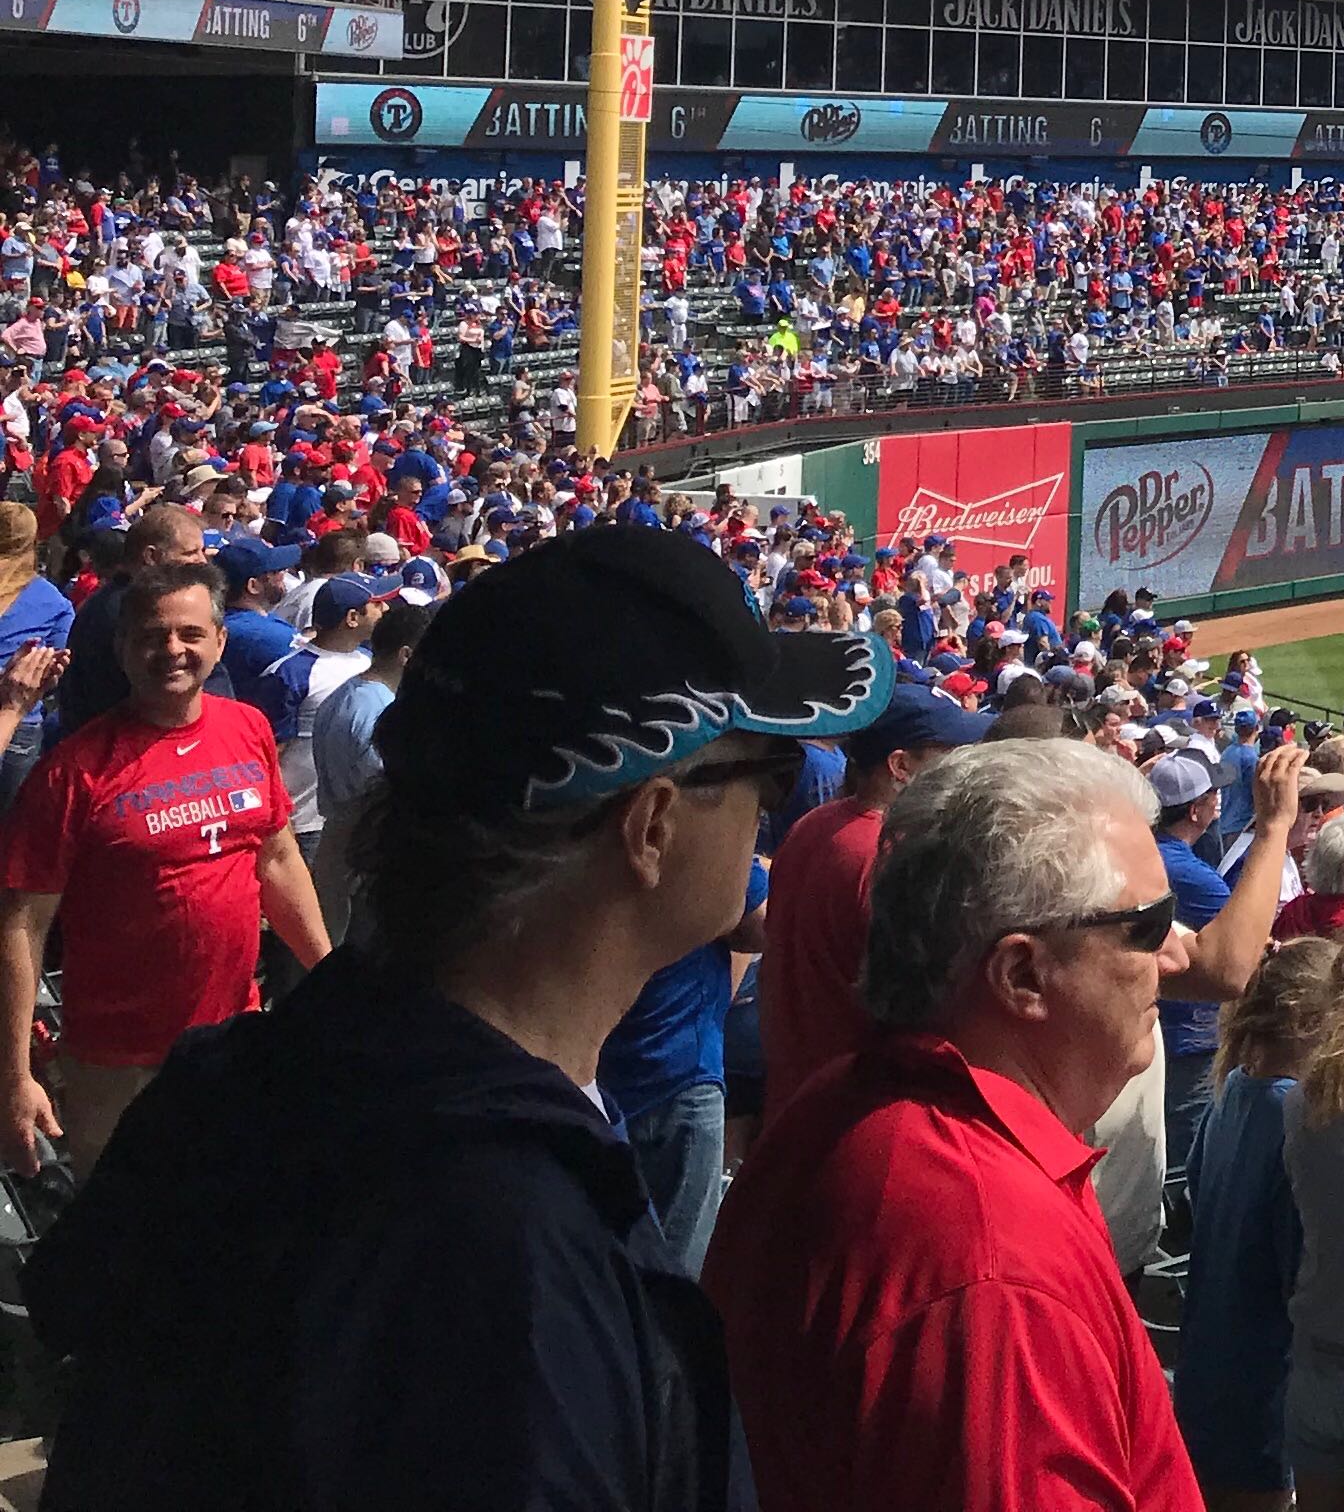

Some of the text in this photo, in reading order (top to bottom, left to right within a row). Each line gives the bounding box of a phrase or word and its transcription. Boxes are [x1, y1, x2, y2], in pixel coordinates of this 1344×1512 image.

[862, 442, 881, 465] 354
[1138, 469, 1181, 509] Dr
[898, 501, 1046, 539] Budweiser
[1107, 483, 1205, 563] Pepper
[145, 794, 230, 836] BASEBALL
[200, 819, 228, 855] T
